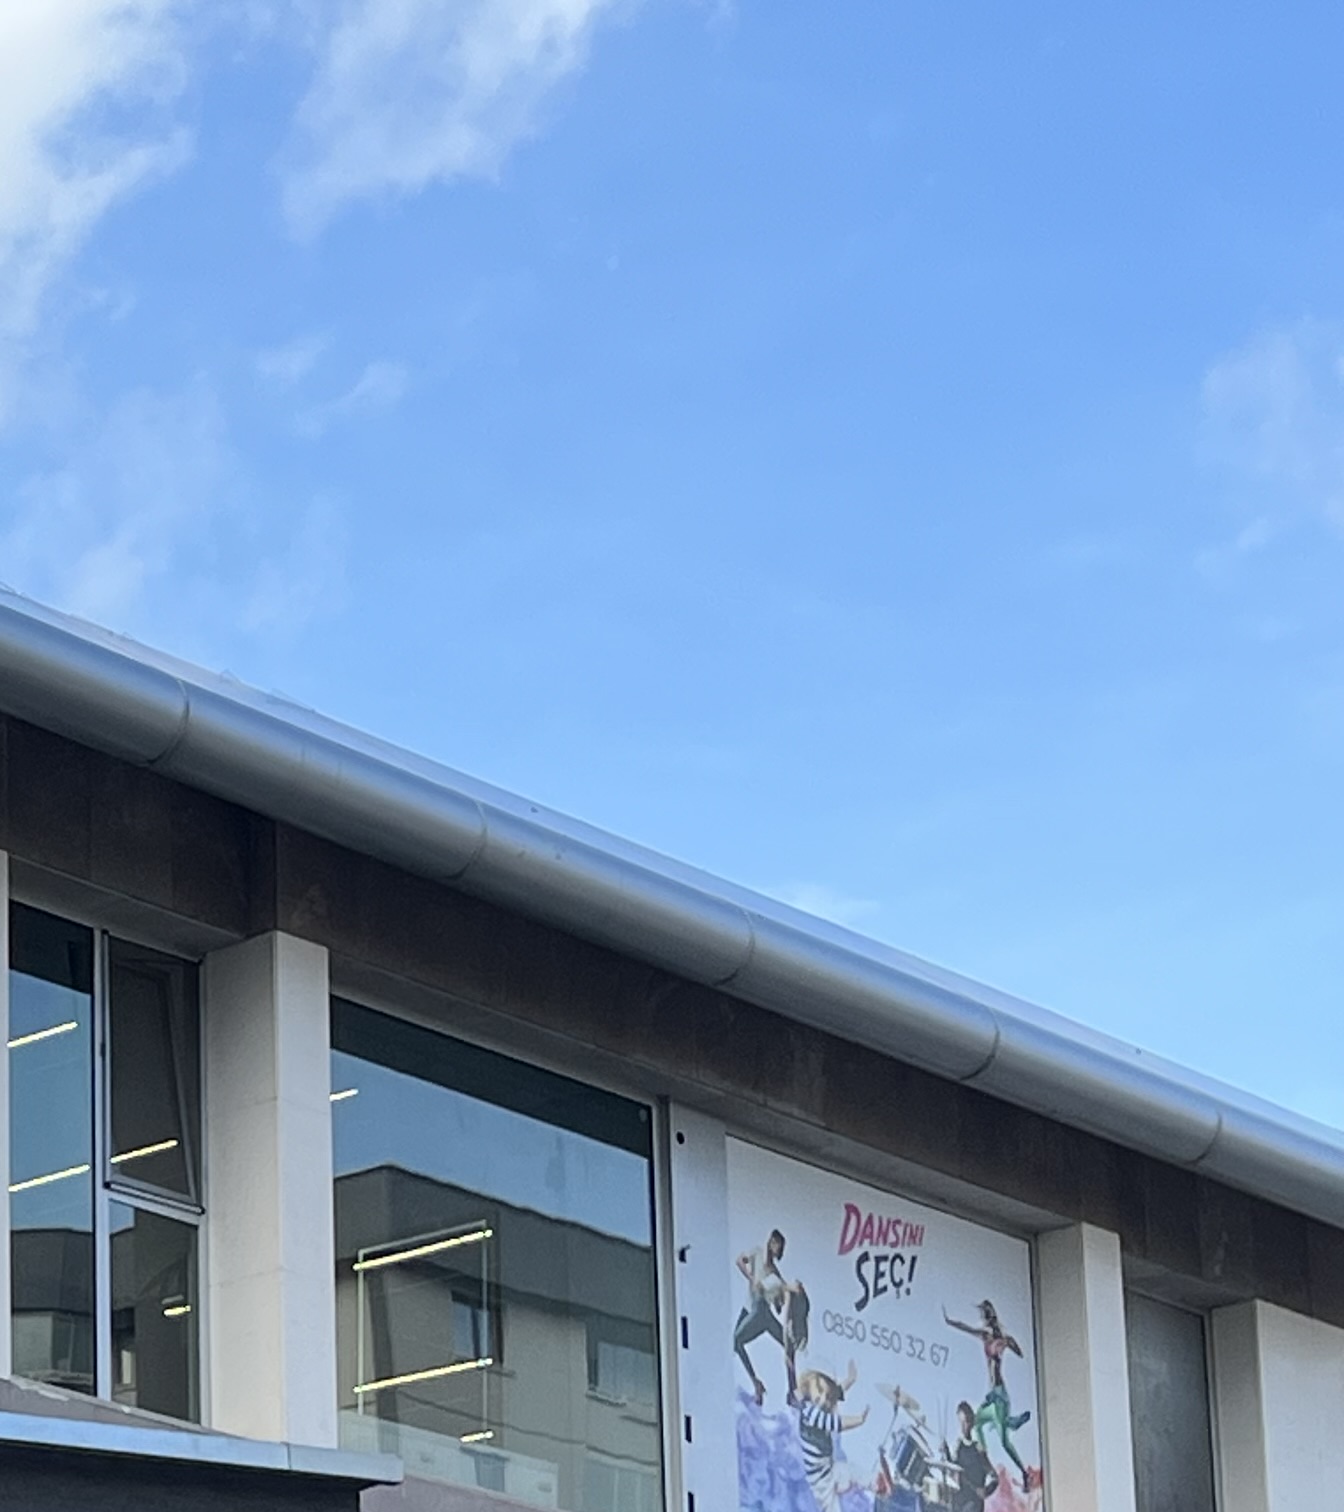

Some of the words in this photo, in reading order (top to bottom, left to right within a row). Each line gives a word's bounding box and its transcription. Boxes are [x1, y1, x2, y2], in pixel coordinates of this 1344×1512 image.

[837, 1202, 926, 1256] DANSINI
[854, 1250, 918, 1313] SEÇ!
[822, 1308, 867, 1343] 0850
[870, 1322, 903, 1354] 550
[906, 1334, 927, 1362] 32
[929, 1342, 950, 1369] 67
